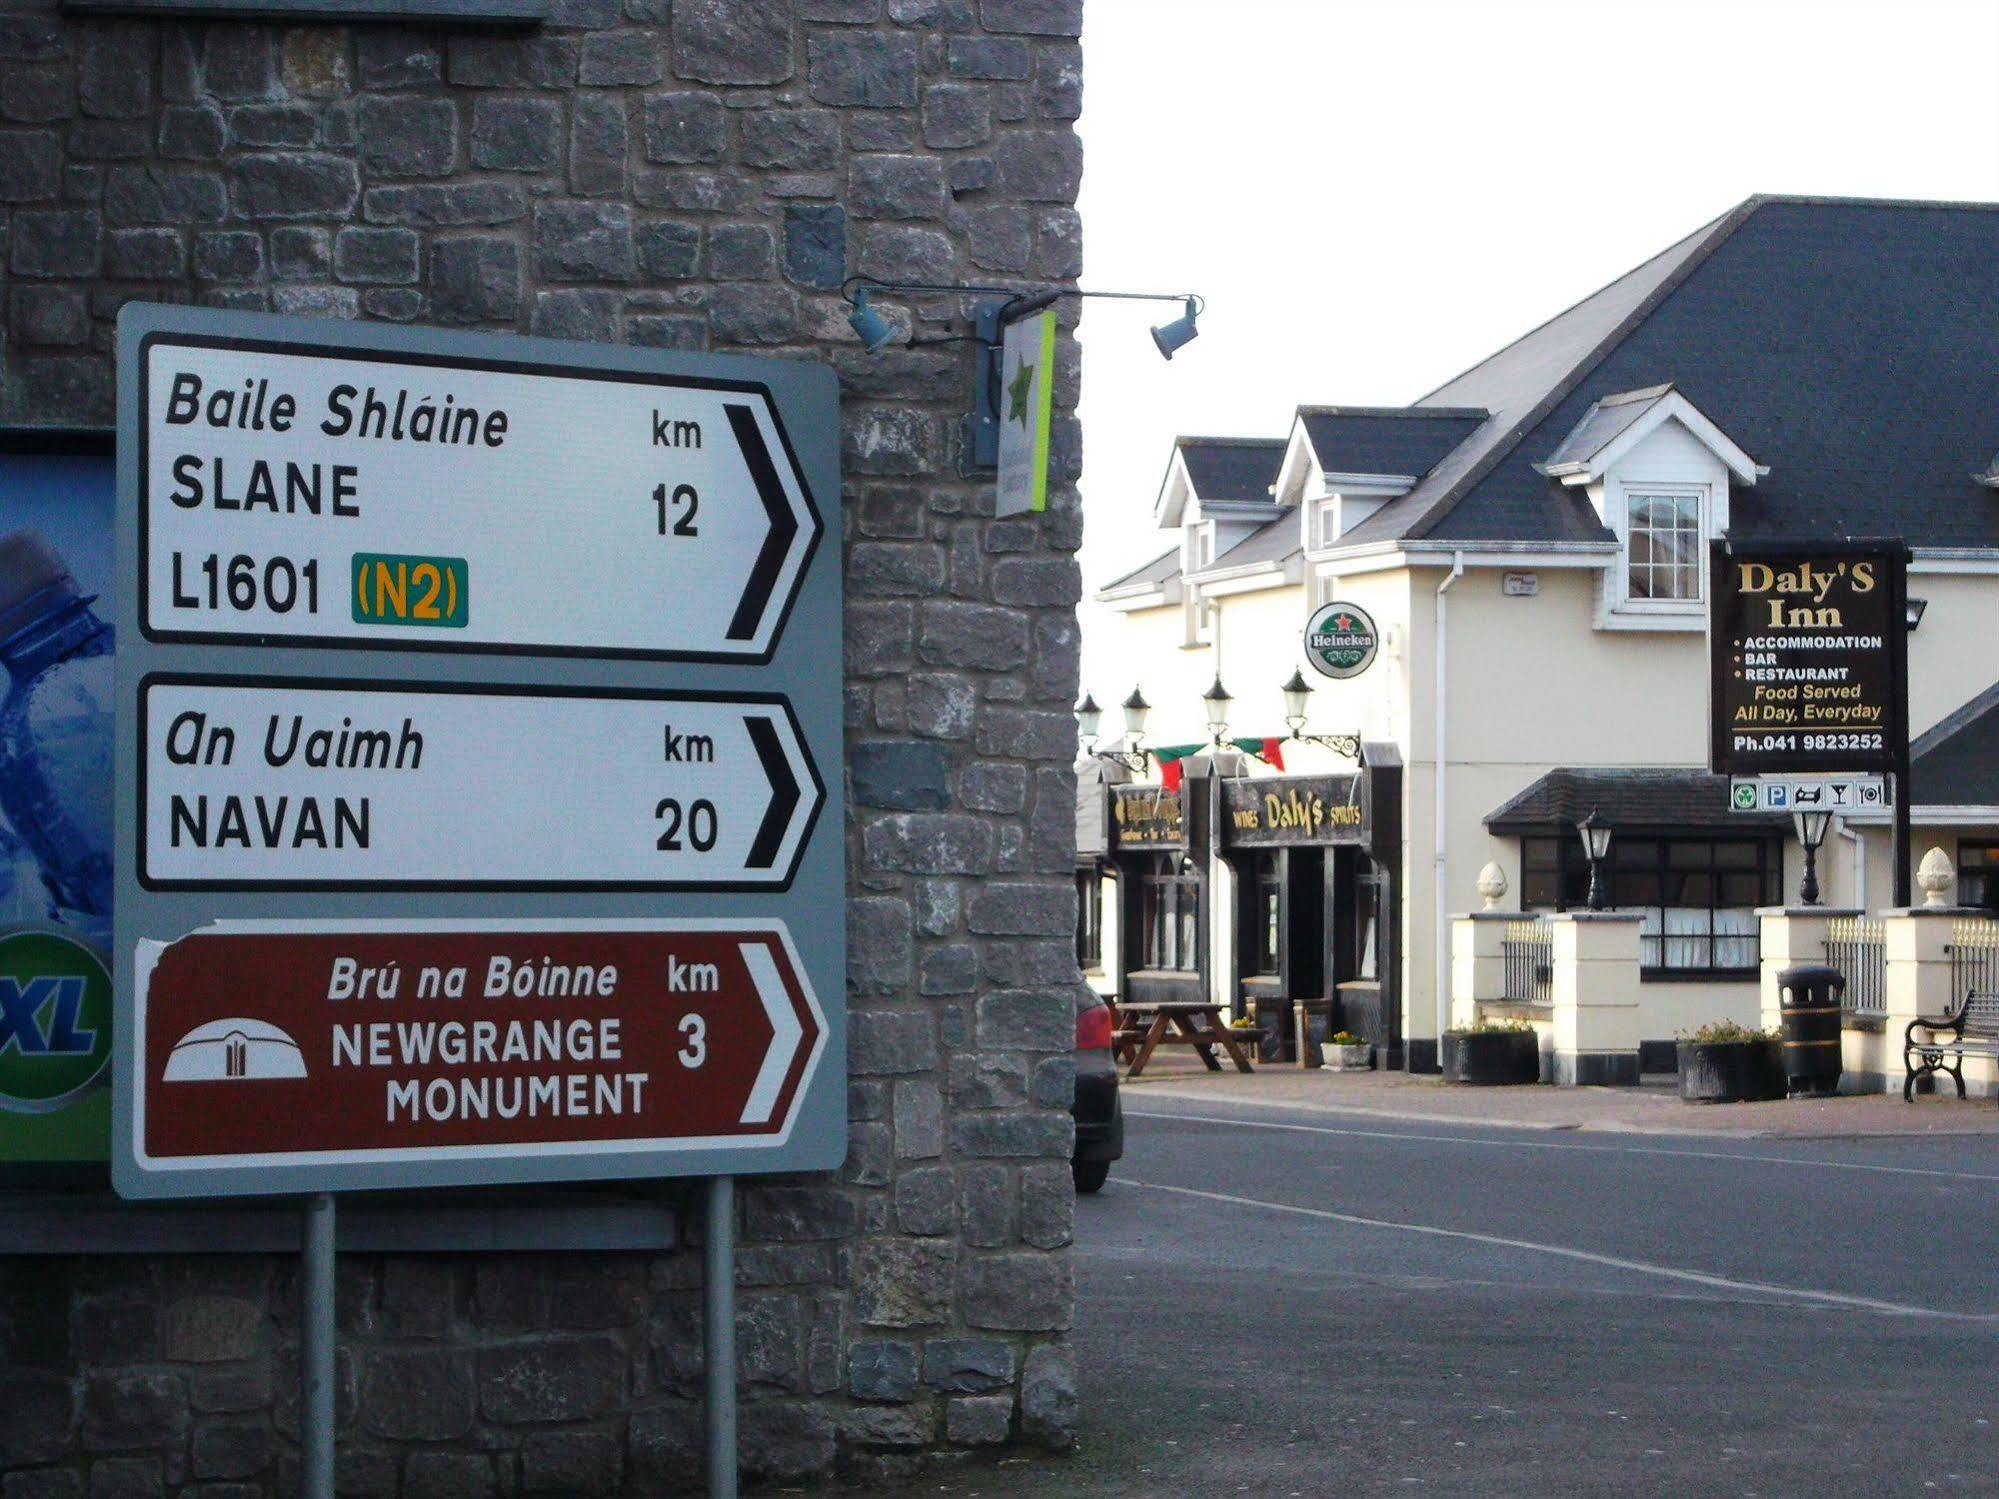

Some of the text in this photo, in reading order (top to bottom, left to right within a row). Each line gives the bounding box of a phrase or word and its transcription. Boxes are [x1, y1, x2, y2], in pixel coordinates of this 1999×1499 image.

[166, 373, 508, 447] Baile Shláine
[653, 410, 702, 449] km
[170, 455, 360, 518] SLANE
[653, 484, 699, 537] 12
[172, 552, 457, 621] L1601 (N2)
[1768, 599, 1843, 628] Inn
[1313, 634, 1372, 647] Heineken
[1744, 636, 1882, 649] ACCOMMODATION
[1745, 653, 1777, 665] BAR
[1745, 668, 1849, 680] RESTAURANT
[1754, 684, 1861, 700] Food Served
[1735, 703, 1882, 723] All Day, Everyday
[166, 711, 424, 769] An Uaimh
[665, 725, 714, 763] km
[1734, 734, 1883, 751] Ph.041 9823252
[171, 795, 370, 849] NAVAN
[656, 798, 718, 852] 20
[328, 956, 618, 1000] Brú na Bóinne
[669, 955, 719, 992] km
[332, 1019, 622, 1067] NEWGRANGE
[678, 1013, 706, 1069] 3
[387, 1073, 648, 1122] MONUMENT
